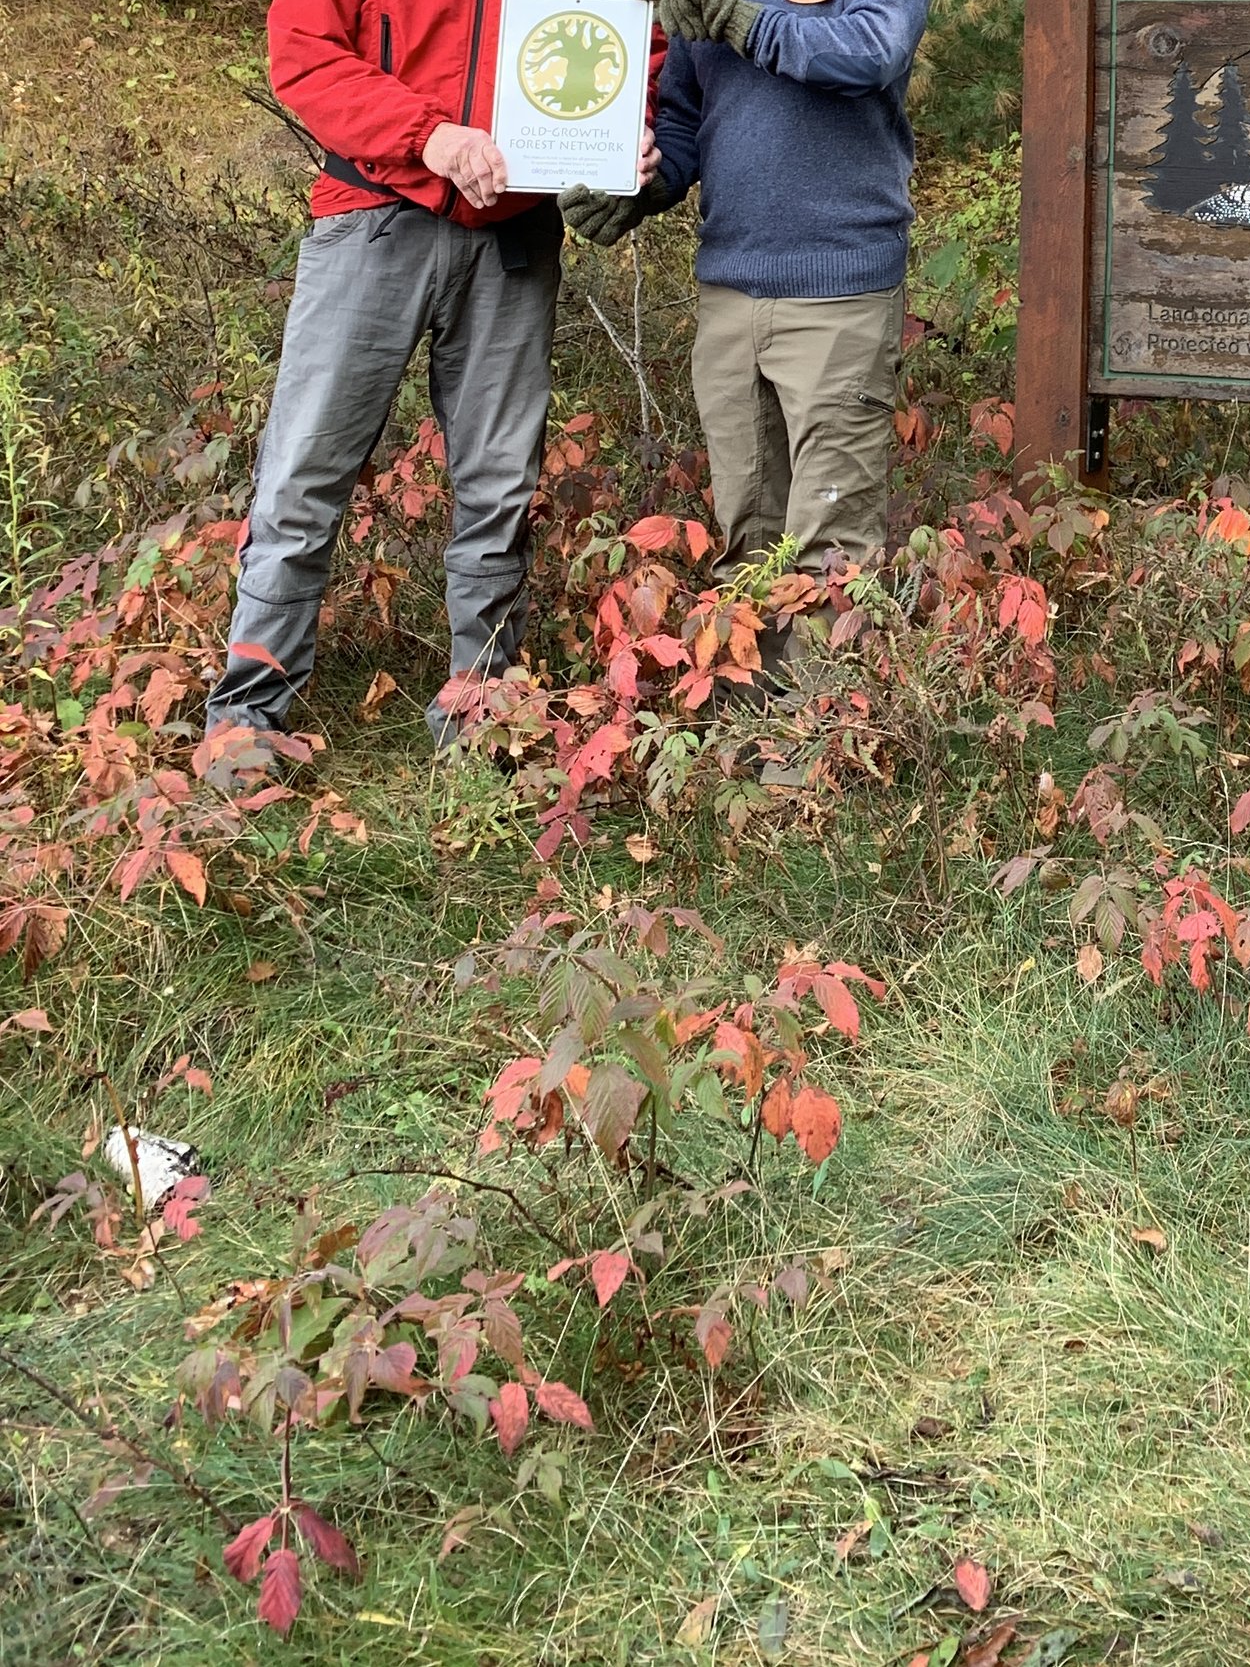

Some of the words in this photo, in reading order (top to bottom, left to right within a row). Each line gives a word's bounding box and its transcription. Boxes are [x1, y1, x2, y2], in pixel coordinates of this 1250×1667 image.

[520, 126, 610, 139] OLD-GROWTH
[509, 138, 556, 150] FOREST
[559, 140, 624, 152] NETWORK
[1149, 304, 1198, 322] Land
[1147, 334, 1240, 355] Protected
